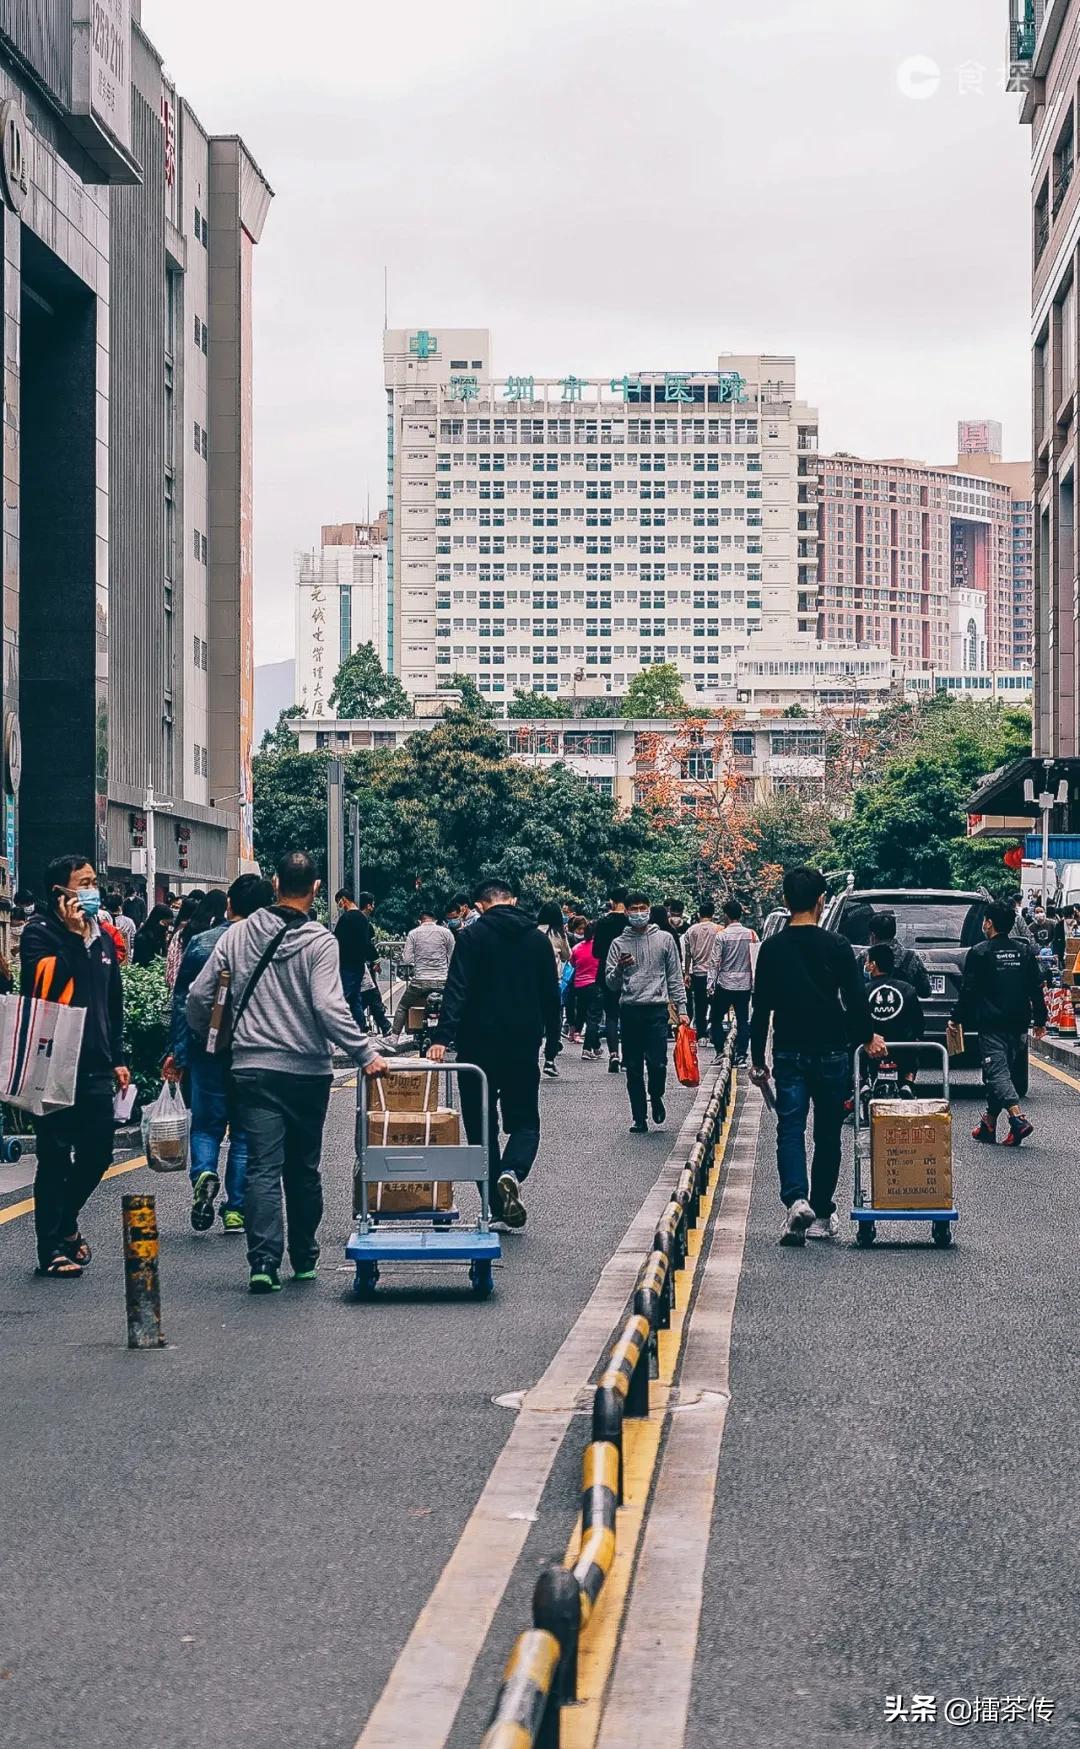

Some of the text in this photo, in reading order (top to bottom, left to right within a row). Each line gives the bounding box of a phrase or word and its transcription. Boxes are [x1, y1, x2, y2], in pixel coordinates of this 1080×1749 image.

[450, 374, 749, 403] 深圳市中医院
